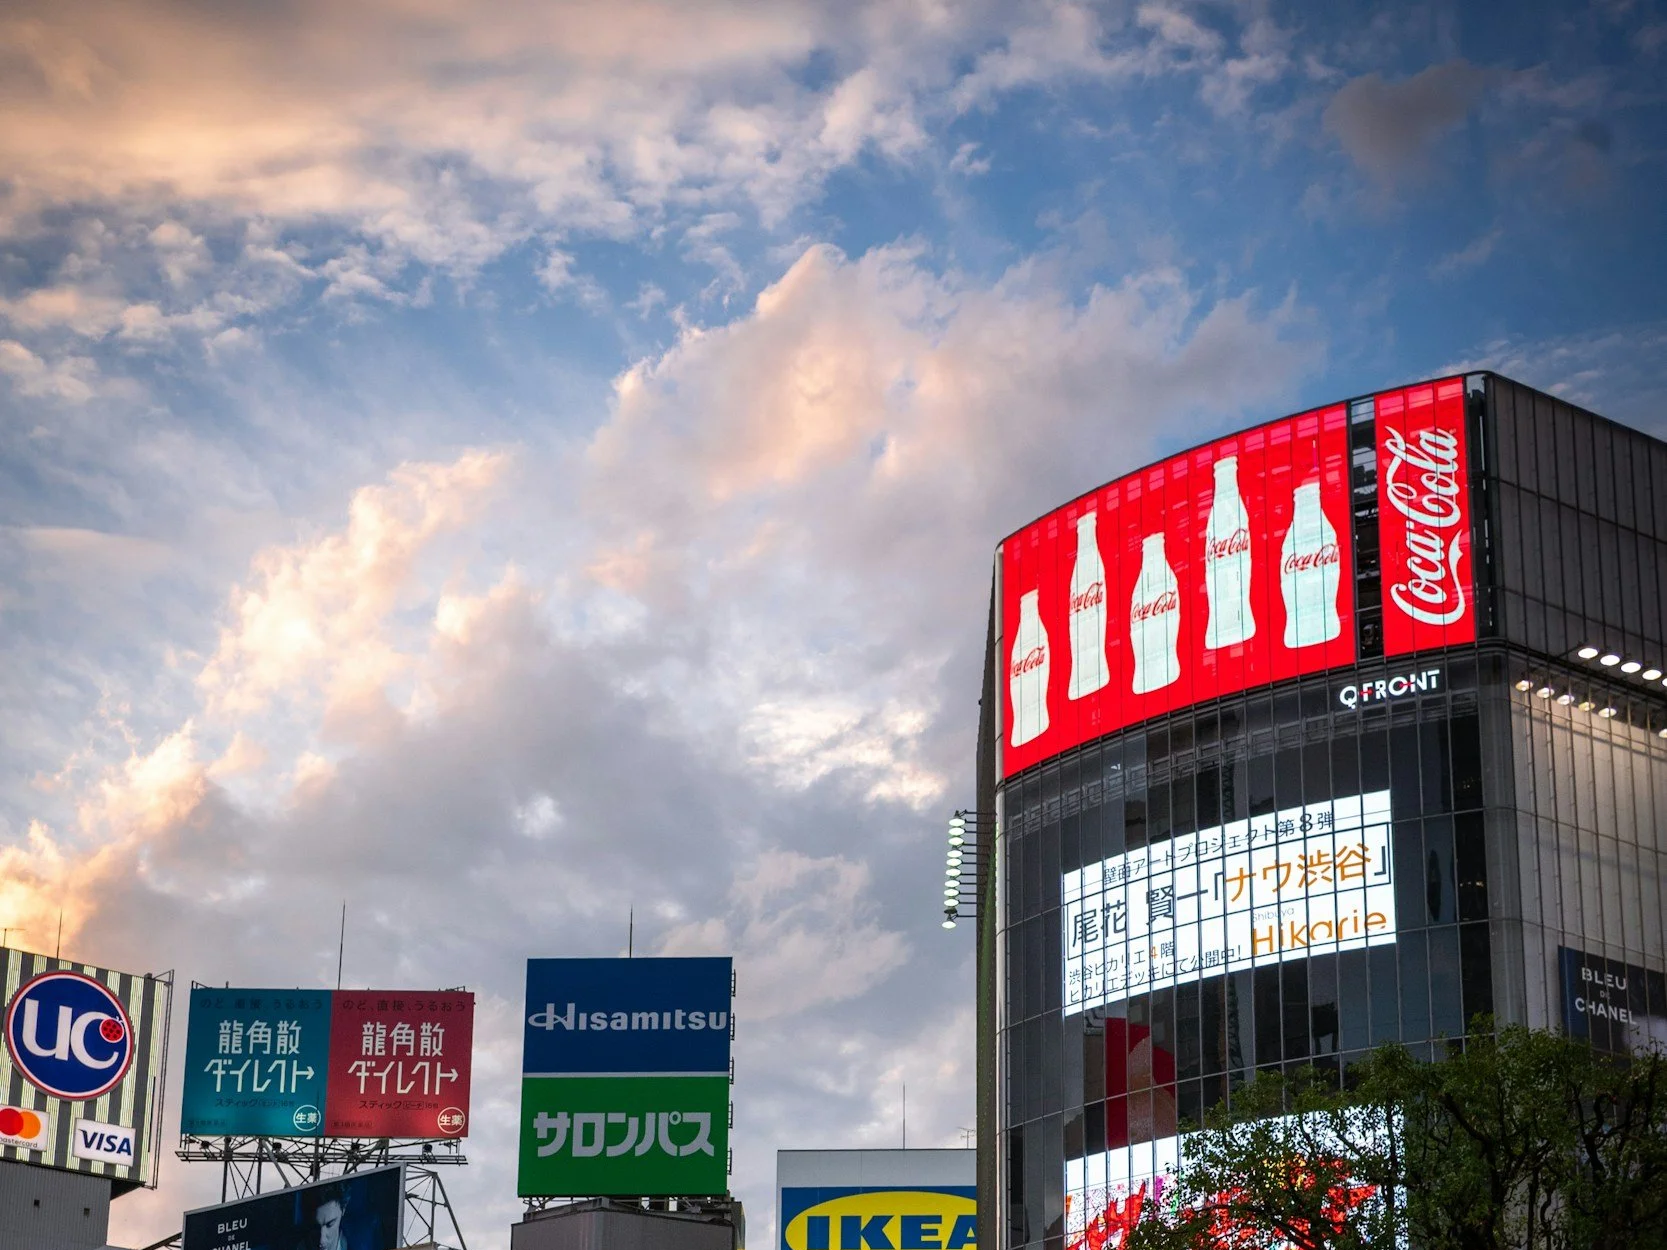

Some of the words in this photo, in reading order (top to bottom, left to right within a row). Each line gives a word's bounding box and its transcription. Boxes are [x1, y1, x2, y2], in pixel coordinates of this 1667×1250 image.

[1339, 669, 1440, 709] QFRONT
[1252, 909, 1387, 956] Hikarie
[1581, 967, 1627, 991] BLEU
[527, 1003, 727, 1031] Hisamitsu
[1575, 996, 1638, 1025] CHANEL
[219, 1020, 302, 1056] 龍角散
[361, 1022, 445, 1058] 龍角散
[203, 1059, 315, 1094] ダイレクト
[347, 1060, 459, 1096] ダイレクト
[296, 1112, 318, 1125] 生薬
[440, 1114, 463, 1127] 生薬
[533, 1110, 715, 1158] サロンパス
[78, 1128, 133, 1156] VISA
[217, 1218, 248, 1235] BLEU
